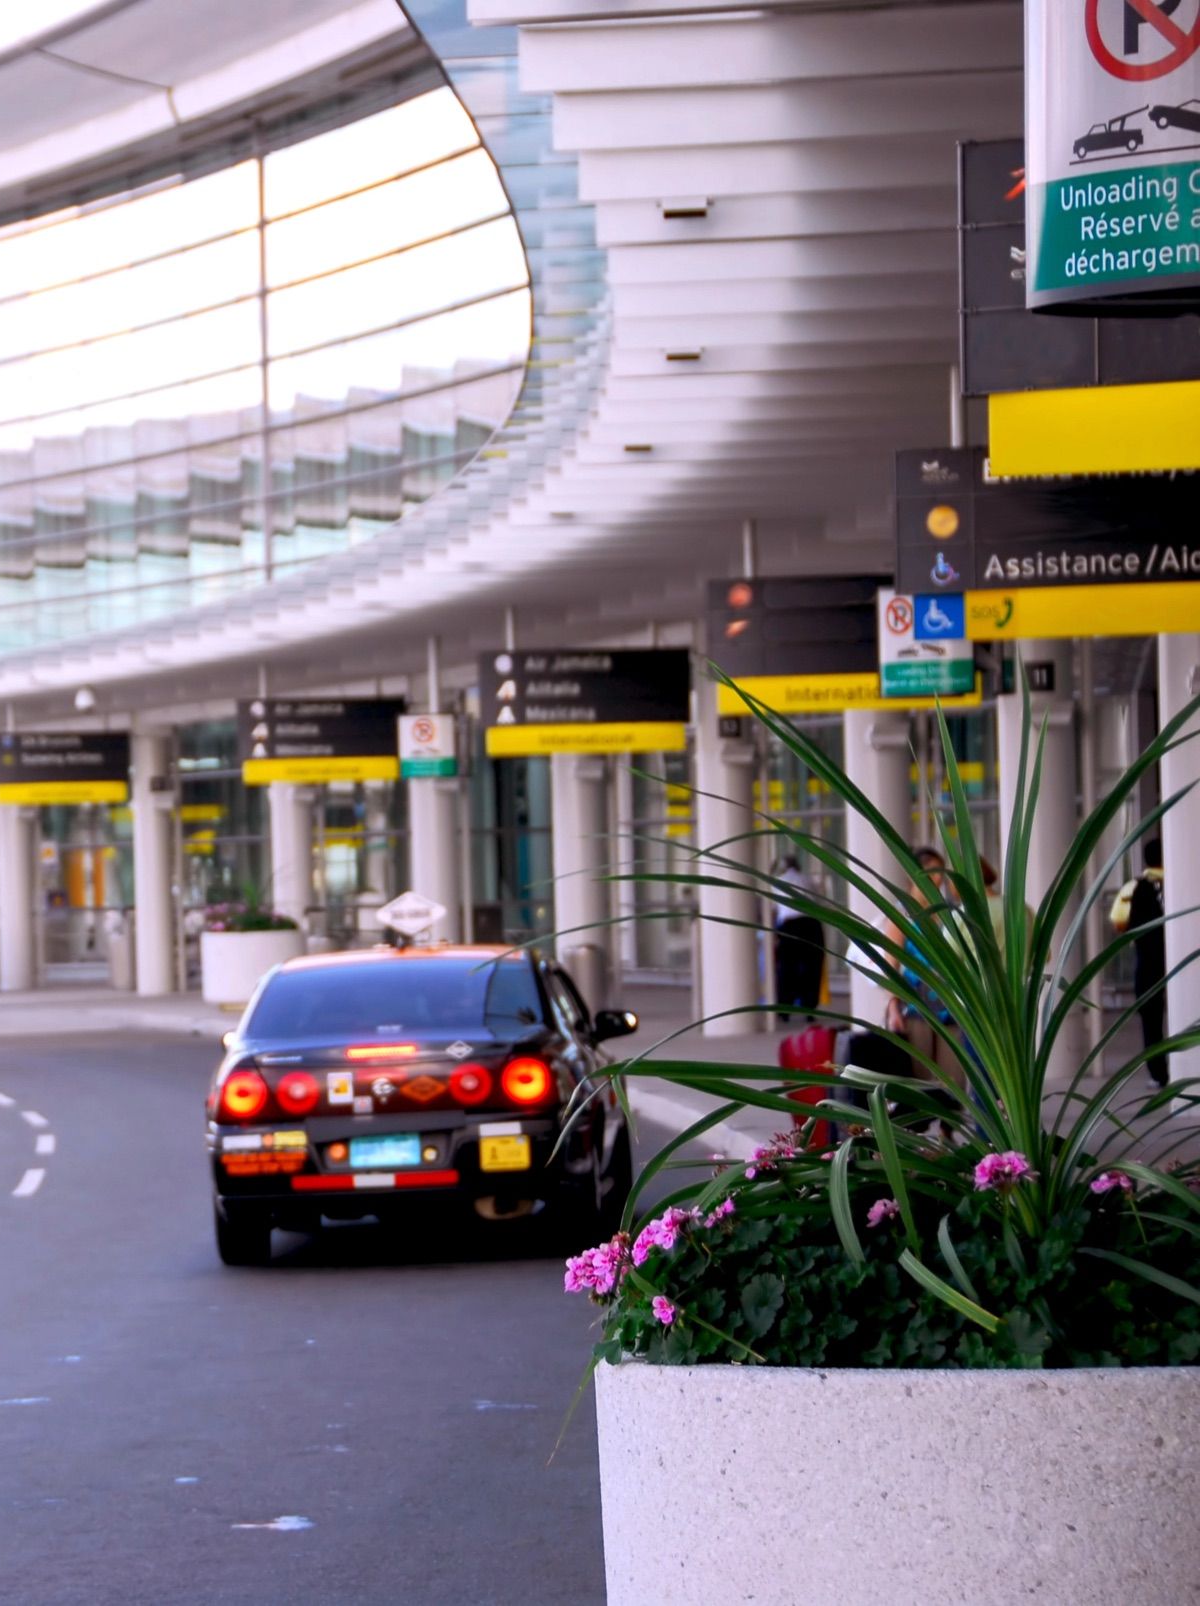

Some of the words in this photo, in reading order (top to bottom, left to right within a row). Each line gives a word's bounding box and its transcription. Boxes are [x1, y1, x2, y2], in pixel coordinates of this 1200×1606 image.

[1060, 174, 1177, 212] Unloading
[1081, 203, 1180, 241] Réservé
[1064, 243, 1200, 278] déchargem
